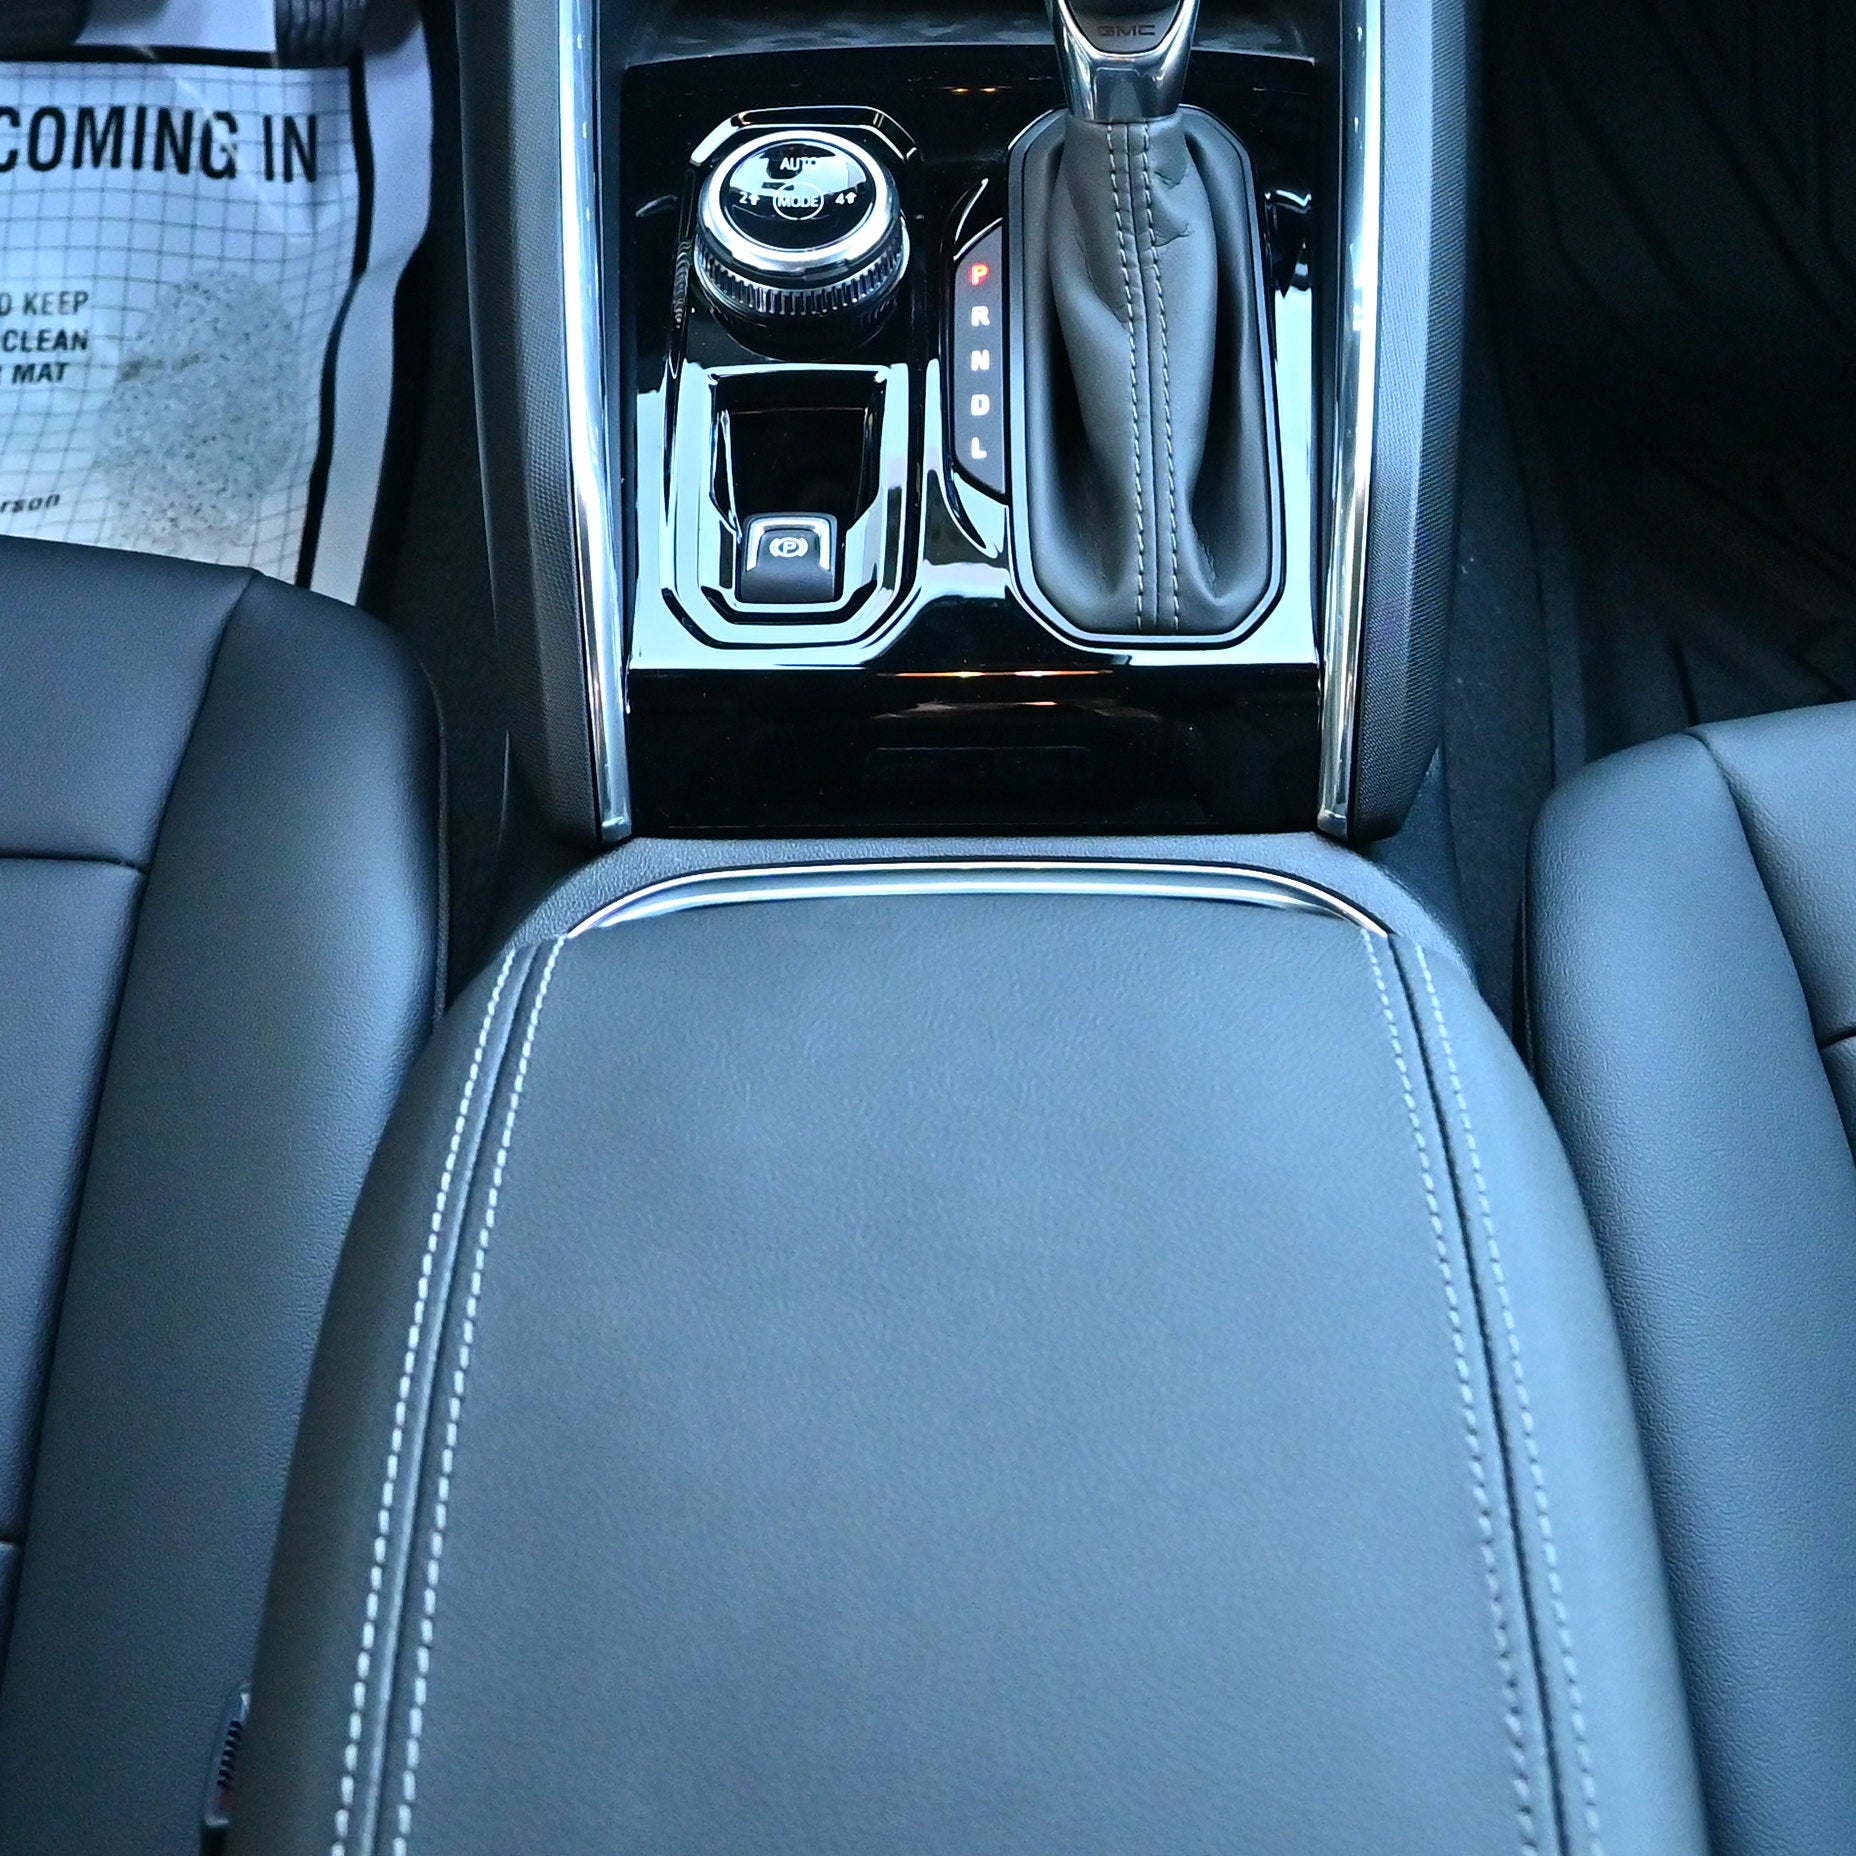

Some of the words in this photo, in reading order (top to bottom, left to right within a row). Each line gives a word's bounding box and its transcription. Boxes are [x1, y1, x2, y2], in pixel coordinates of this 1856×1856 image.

[264, 113, 319, 183] IN
[777, 195, 820, 208] MODE
[834, 193, 845, 205] 4
[969, 264, 989, 286] P
[23, 290, 90, 316] KEEP
[971, 306, 990, 327] R
[1, 328, 90, 352] CLEAN
[971, 348, 990, 371] N
[11, 361, 71, 384] MAT
[971, 393, 990, 417] D
[970, 437, 988, 460] L
